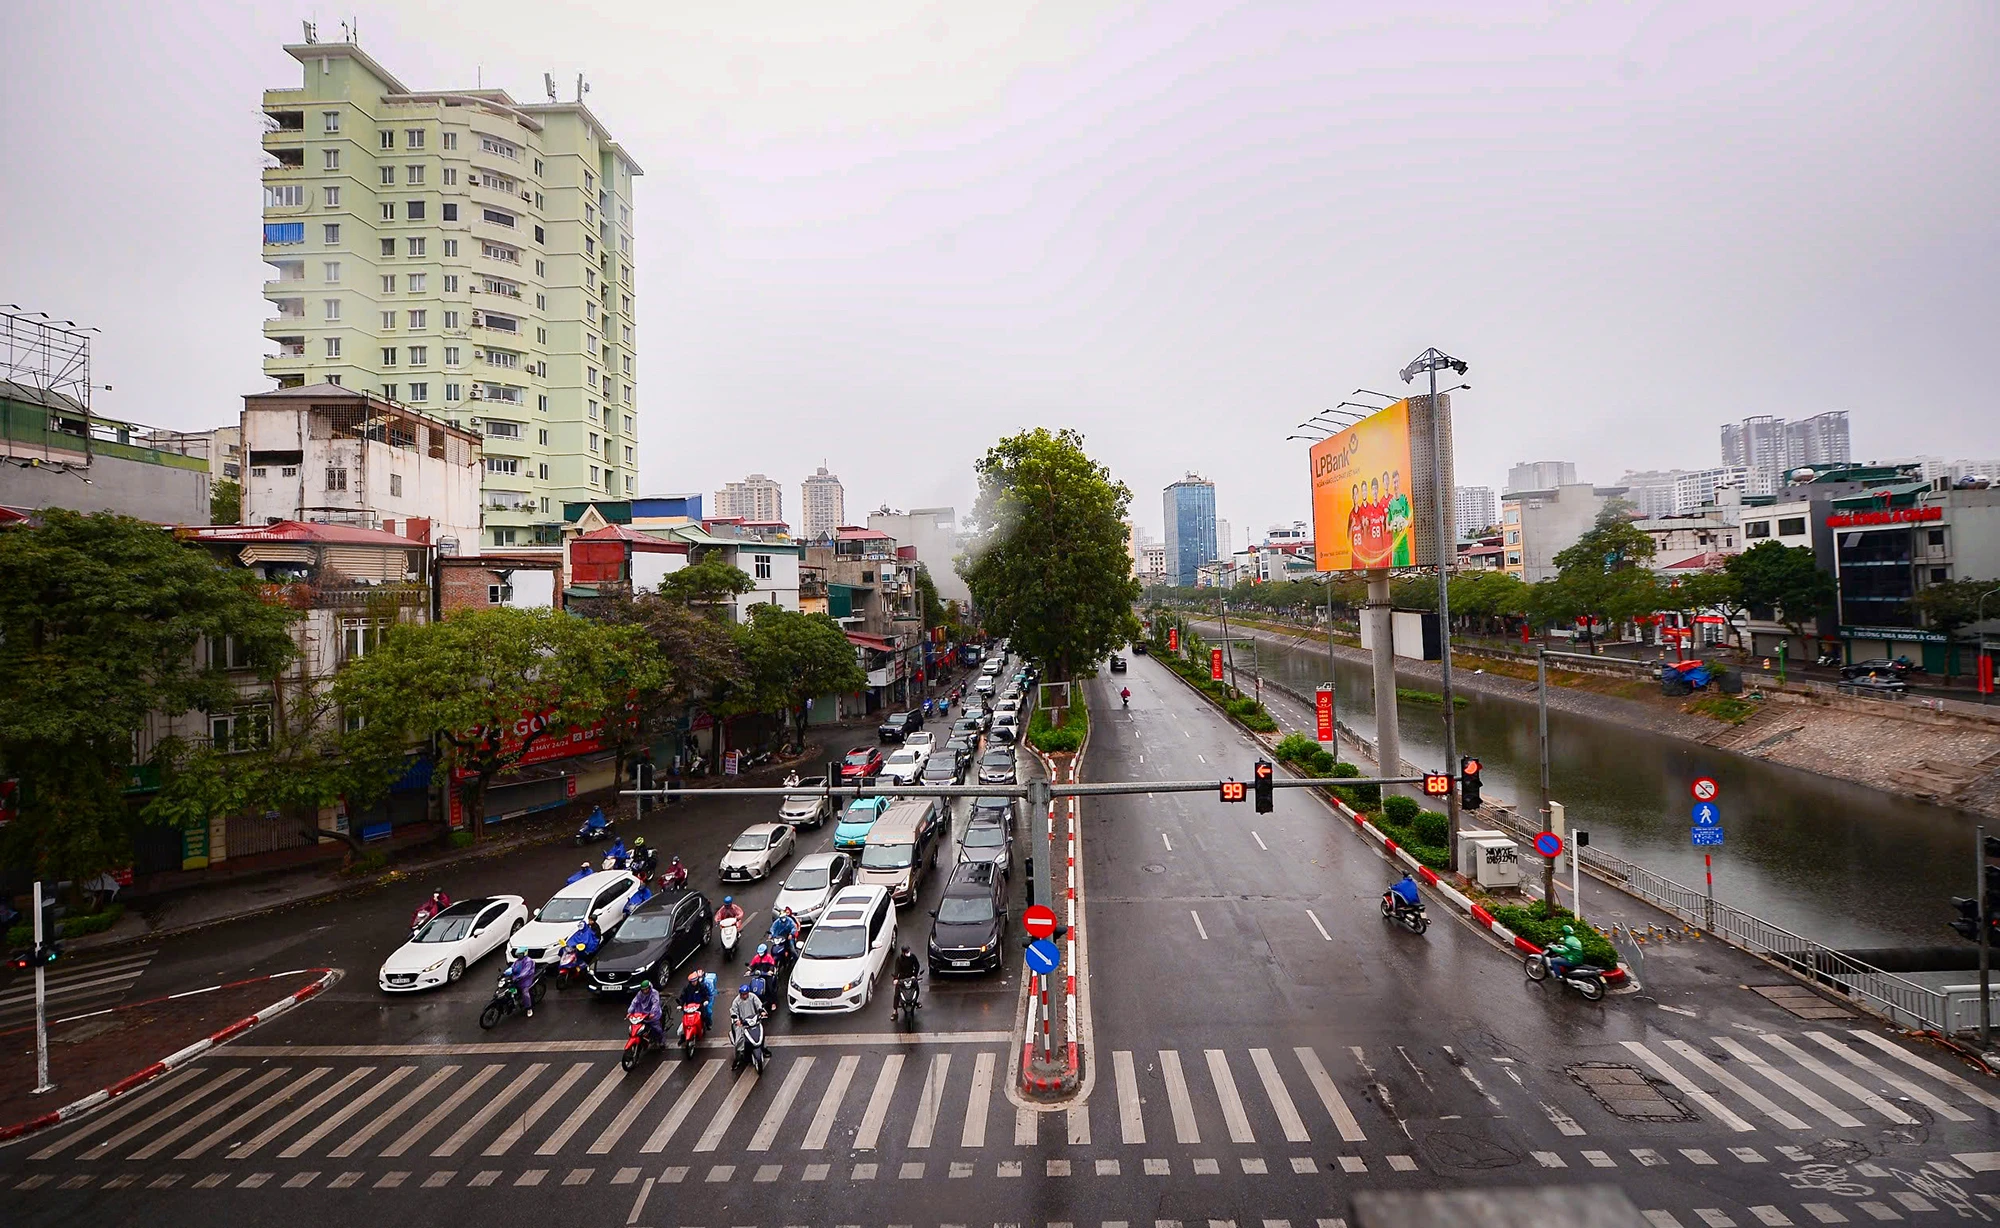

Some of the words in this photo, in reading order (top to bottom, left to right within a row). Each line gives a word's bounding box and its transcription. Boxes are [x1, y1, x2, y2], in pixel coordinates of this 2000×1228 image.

[1315, 447, 1349, 478] LPBank
[1371, 525, 1380, 538] 68
[1353, 533, 1362, 545] 68
[1223, 784, 1242, 798] 99
[1428, 776, 1447, 792] 68
